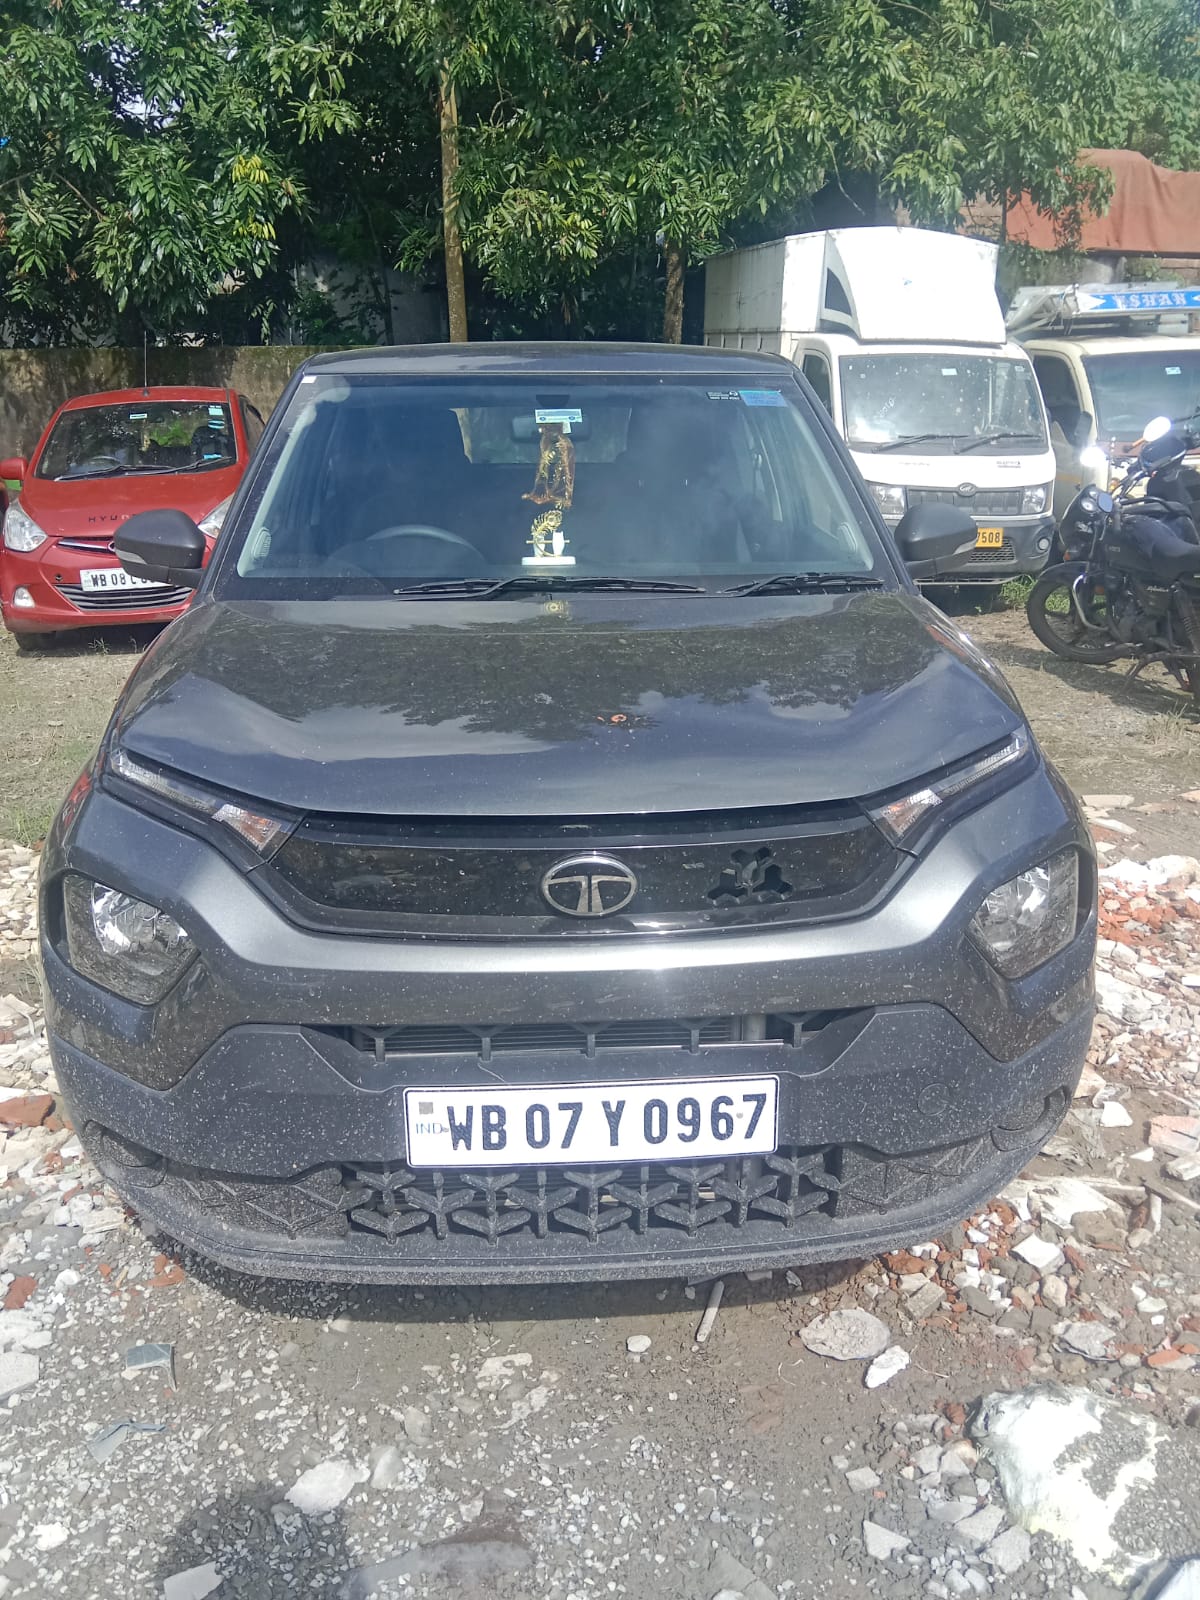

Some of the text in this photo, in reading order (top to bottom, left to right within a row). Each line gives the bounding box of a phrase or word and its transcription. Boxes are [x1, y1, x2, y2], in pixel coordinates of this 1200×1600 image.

[91, 574, 107, 587] WB
[111, 573, 126, 586] 08
[416, 1122, 443, 1135] IND
[447, 1093, 767, 1151] WB 07 Y 0967
